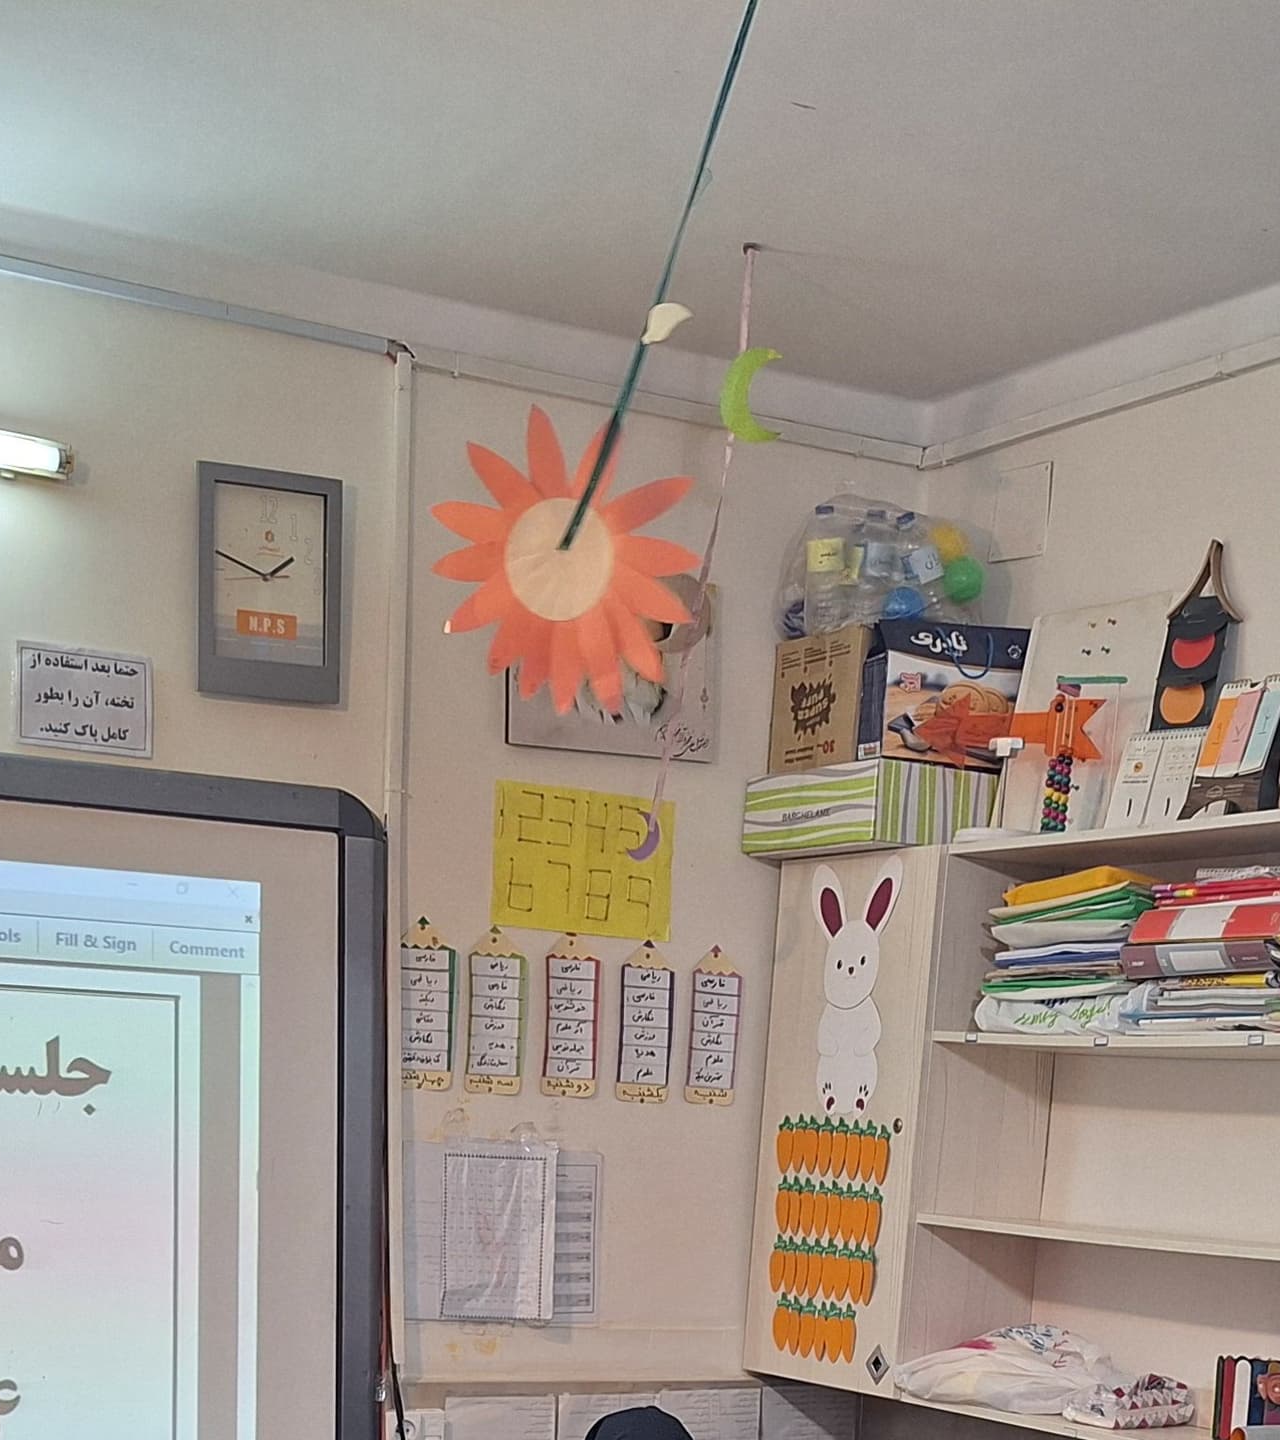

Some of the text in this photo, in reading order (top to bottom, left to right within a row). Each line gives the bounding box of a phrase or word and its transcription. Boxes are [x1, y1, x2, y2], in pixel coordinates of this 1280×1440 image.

[248, 614, 286, 635] N.P.S
[29, 653, 139, 679] حتما بعد استفاده از
[35, 687, 64, 704] بطور
[68, 690, 79, 707] را
[82, 690, 100, 708] آن
[40, 722, 129, 743] کامل پاک کنید.
[517, 790, 545, 845] 2
[546, 795, 577, 847] 3
[585, 800, 609, 853] 4
[507, 856, 652, 928] 6 7 8 9
[55, 931, 81, 949] Fill
[83, 933, 99, 950] &
[102, 935, 137, 954] Sign
[169, 940, 246, 960] Comment
